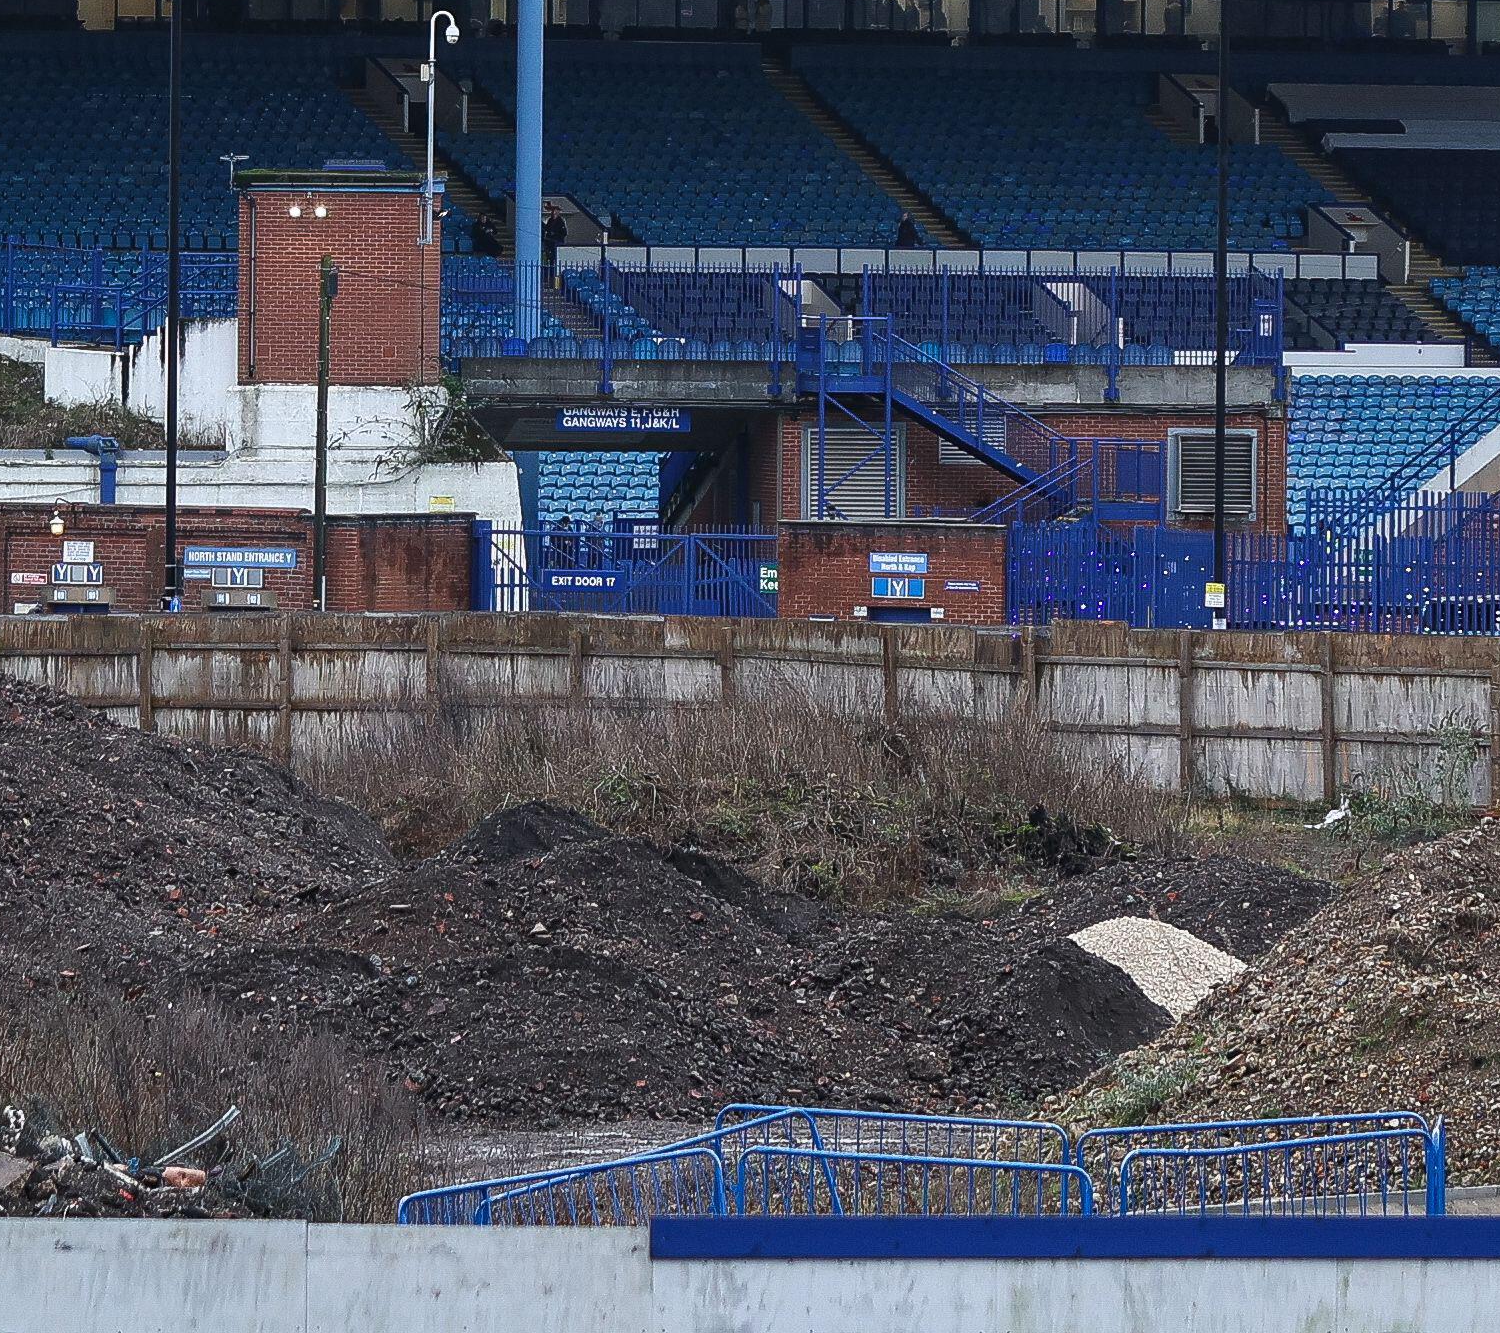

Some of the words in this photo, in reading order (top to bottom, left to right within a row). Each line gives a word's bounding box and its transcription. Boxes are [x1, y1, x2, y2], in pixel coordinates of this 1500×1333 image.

[563, 407, 628, 417] GANGWAYS
[563, 417, 627, 428] GANGWAYS
[188, 551, 215, 562] NORTH
[216, 552, 243, 562] STAND
[244, 552, 284, 563] ENTRANCE
[285, 553, 292, 563] Y
[56, 564, 67, 580] Y
[89, 564, 101, 580] Y
[232, 568, 244, 584] Y
[551, 576, 573, 586] EXIT
[575, 576, 603, 587] DOOR
[605, 577, 616, 587] 17
[891, 580, 904, 597] Y
